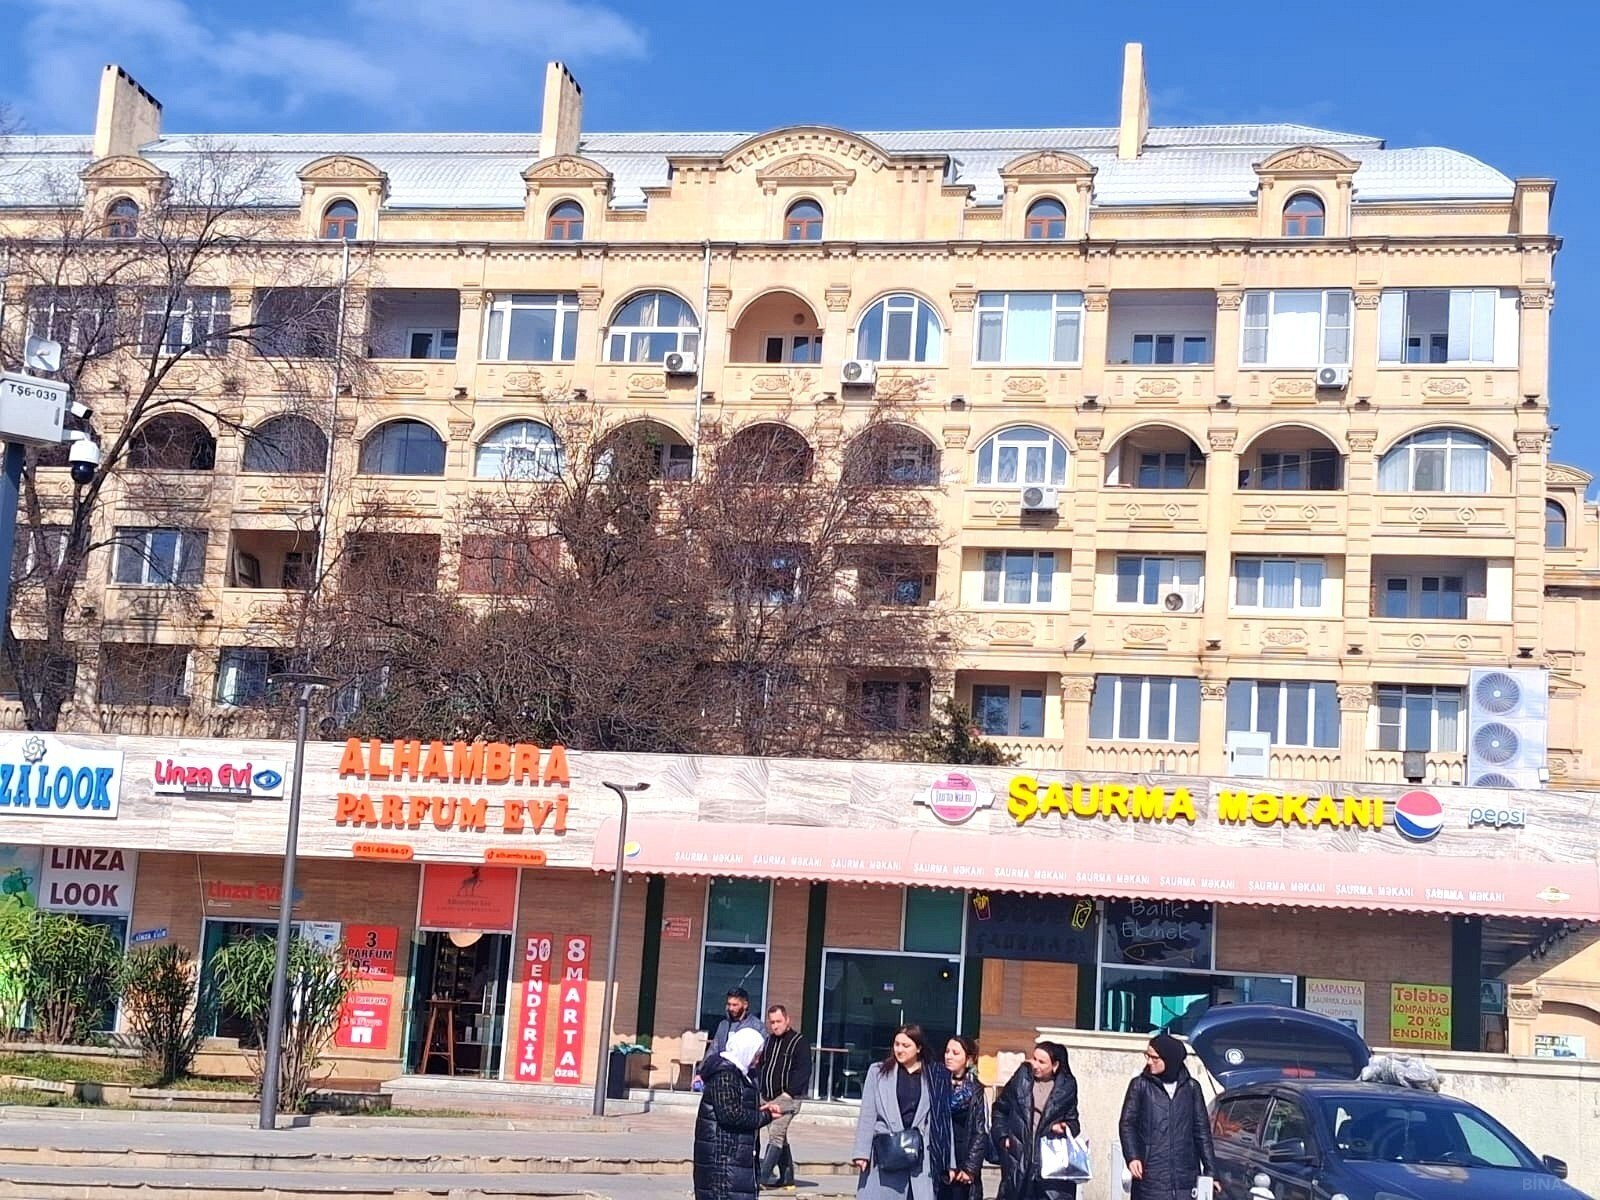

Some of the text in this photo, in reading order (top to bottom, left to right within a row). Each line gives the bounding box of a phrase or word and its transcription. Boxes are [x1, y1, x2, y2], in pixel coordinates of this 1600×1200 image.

[155, 759, 252, 788] Linza Evi
[338, 738, 570, 787] ALHAMBRA
[1008, 774, 1384, 829] ŞAURMA MƏKANI
[336, 793, 569, 836] PARFUM EVİ
[1469, 806, 1527, 827] pepsi
[51, 847, 125, 871] LINZA
[50, 883, 119, 907] LOOK
[366, 931, 377, 947] 3
[567, 939, 586, 962] 8
[348, 948, 393, 959] PARFUM
[1394, 987, 1449, 1004] Tələbə
[560, 966, 584, 1066] MARTA
[1407, 1016, 1441, 1027] 20 %
[1393, 1028, 1448, 1041] ENDİRİM
